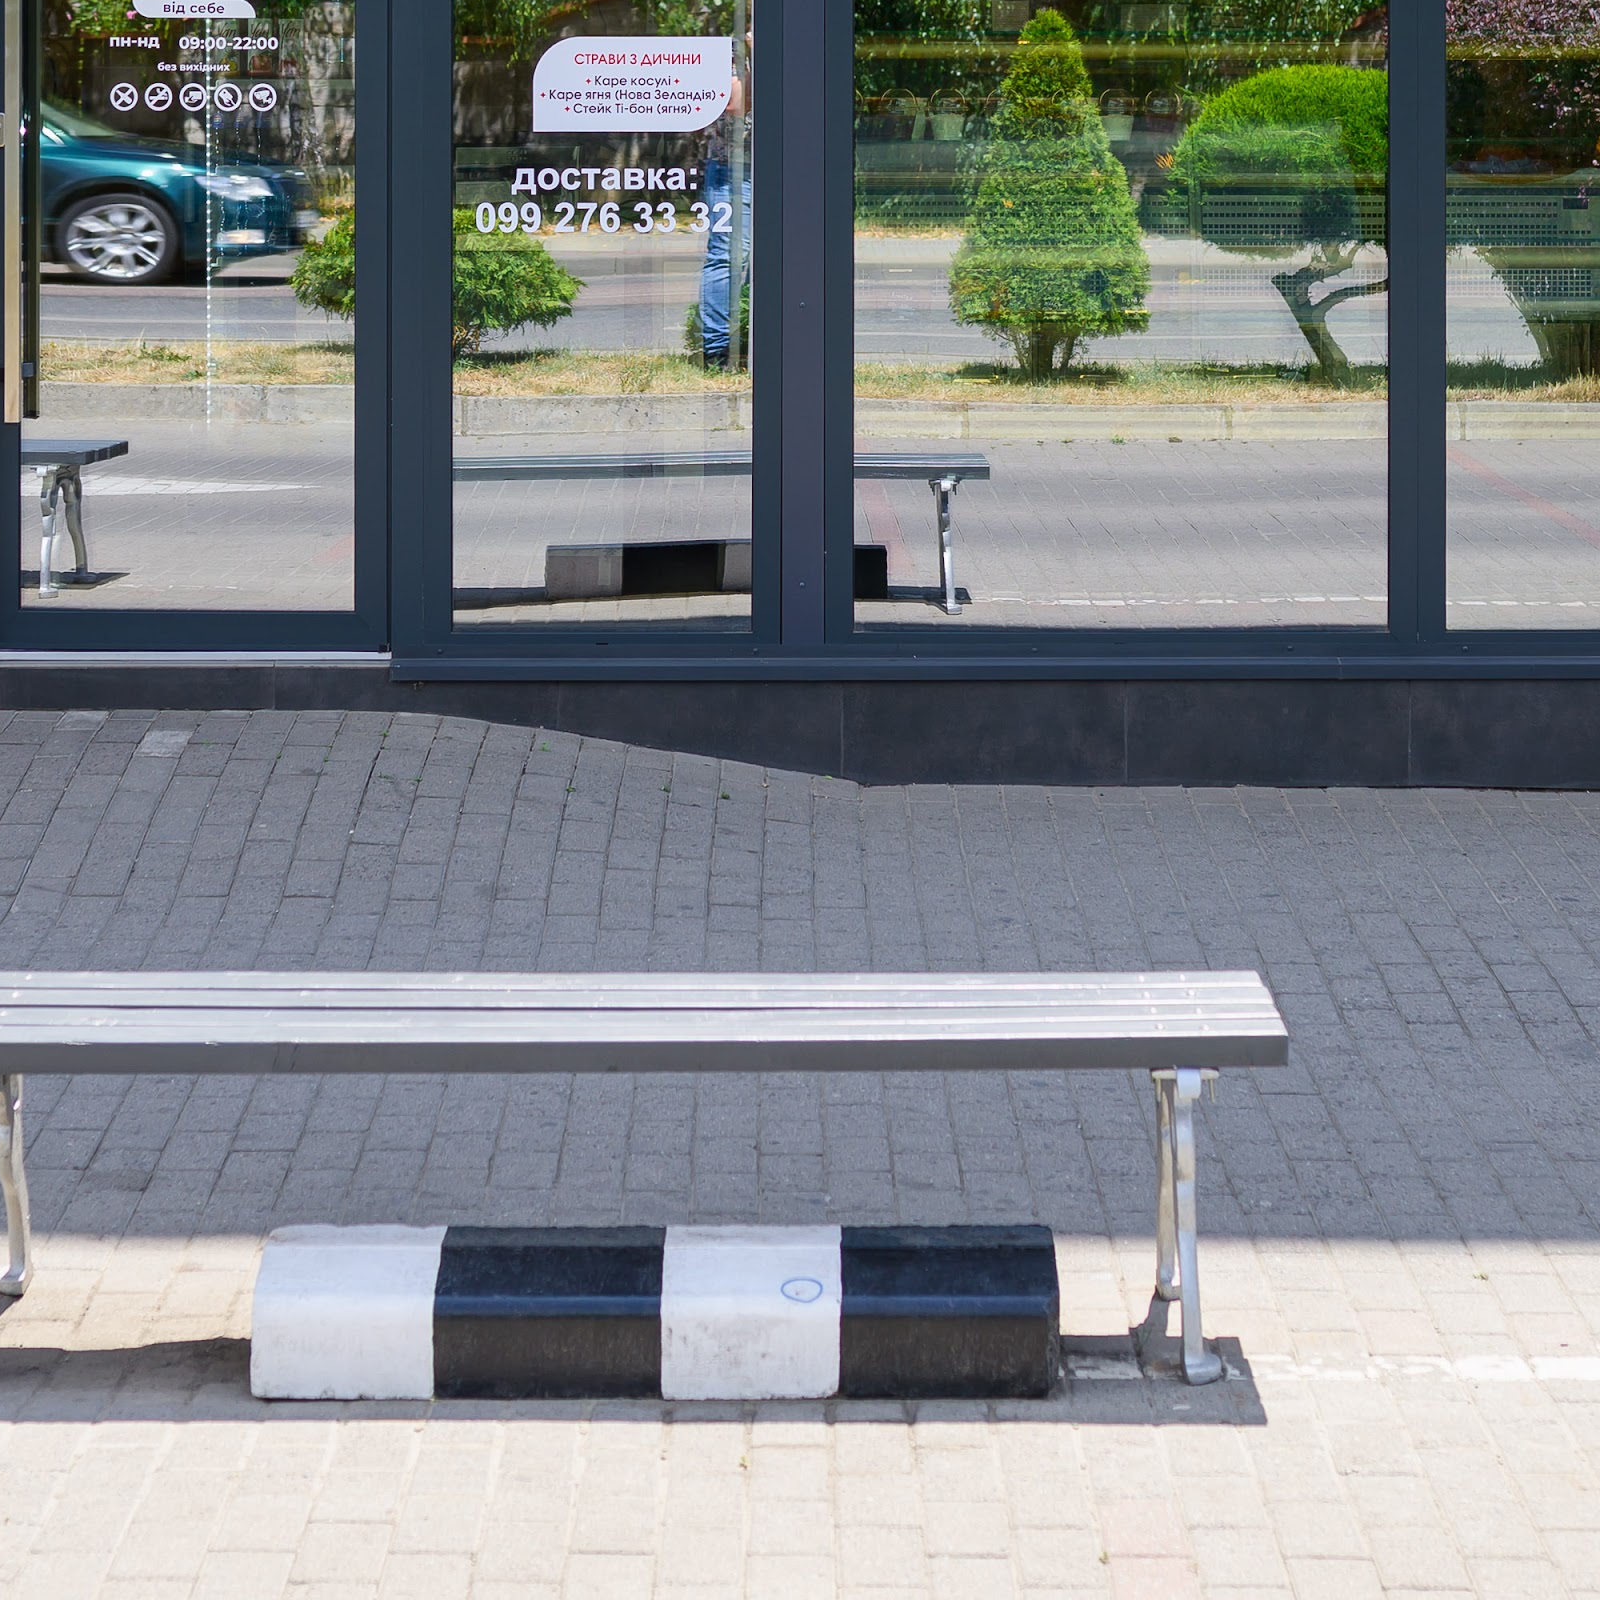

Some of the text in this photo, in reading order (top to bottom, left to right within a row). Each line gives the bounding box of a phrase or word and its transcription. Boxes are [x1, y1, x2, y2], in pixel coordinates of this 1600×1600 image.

[164, 1, 224, 14] від себе
[110, 37, 278, 50] пн-нд 09:00-22:00
[574, 54, 700, 65] СТРАВИ З ДИЧИНИ
[158, 62, 230, 73] без вихідних
[595, 76, 670, 88] Каре косулі
[550, 90, 582, 101] Каре
[615, 90, 650, 100] (Нова
[655, 90, 715, 101] Зеландія)
[573, 103, 691, 114] Стейк Ті-бон (ягня)
[512, 167, 698, 195] доставка:
[475, 202, 733, 233] 099 276 33 32
